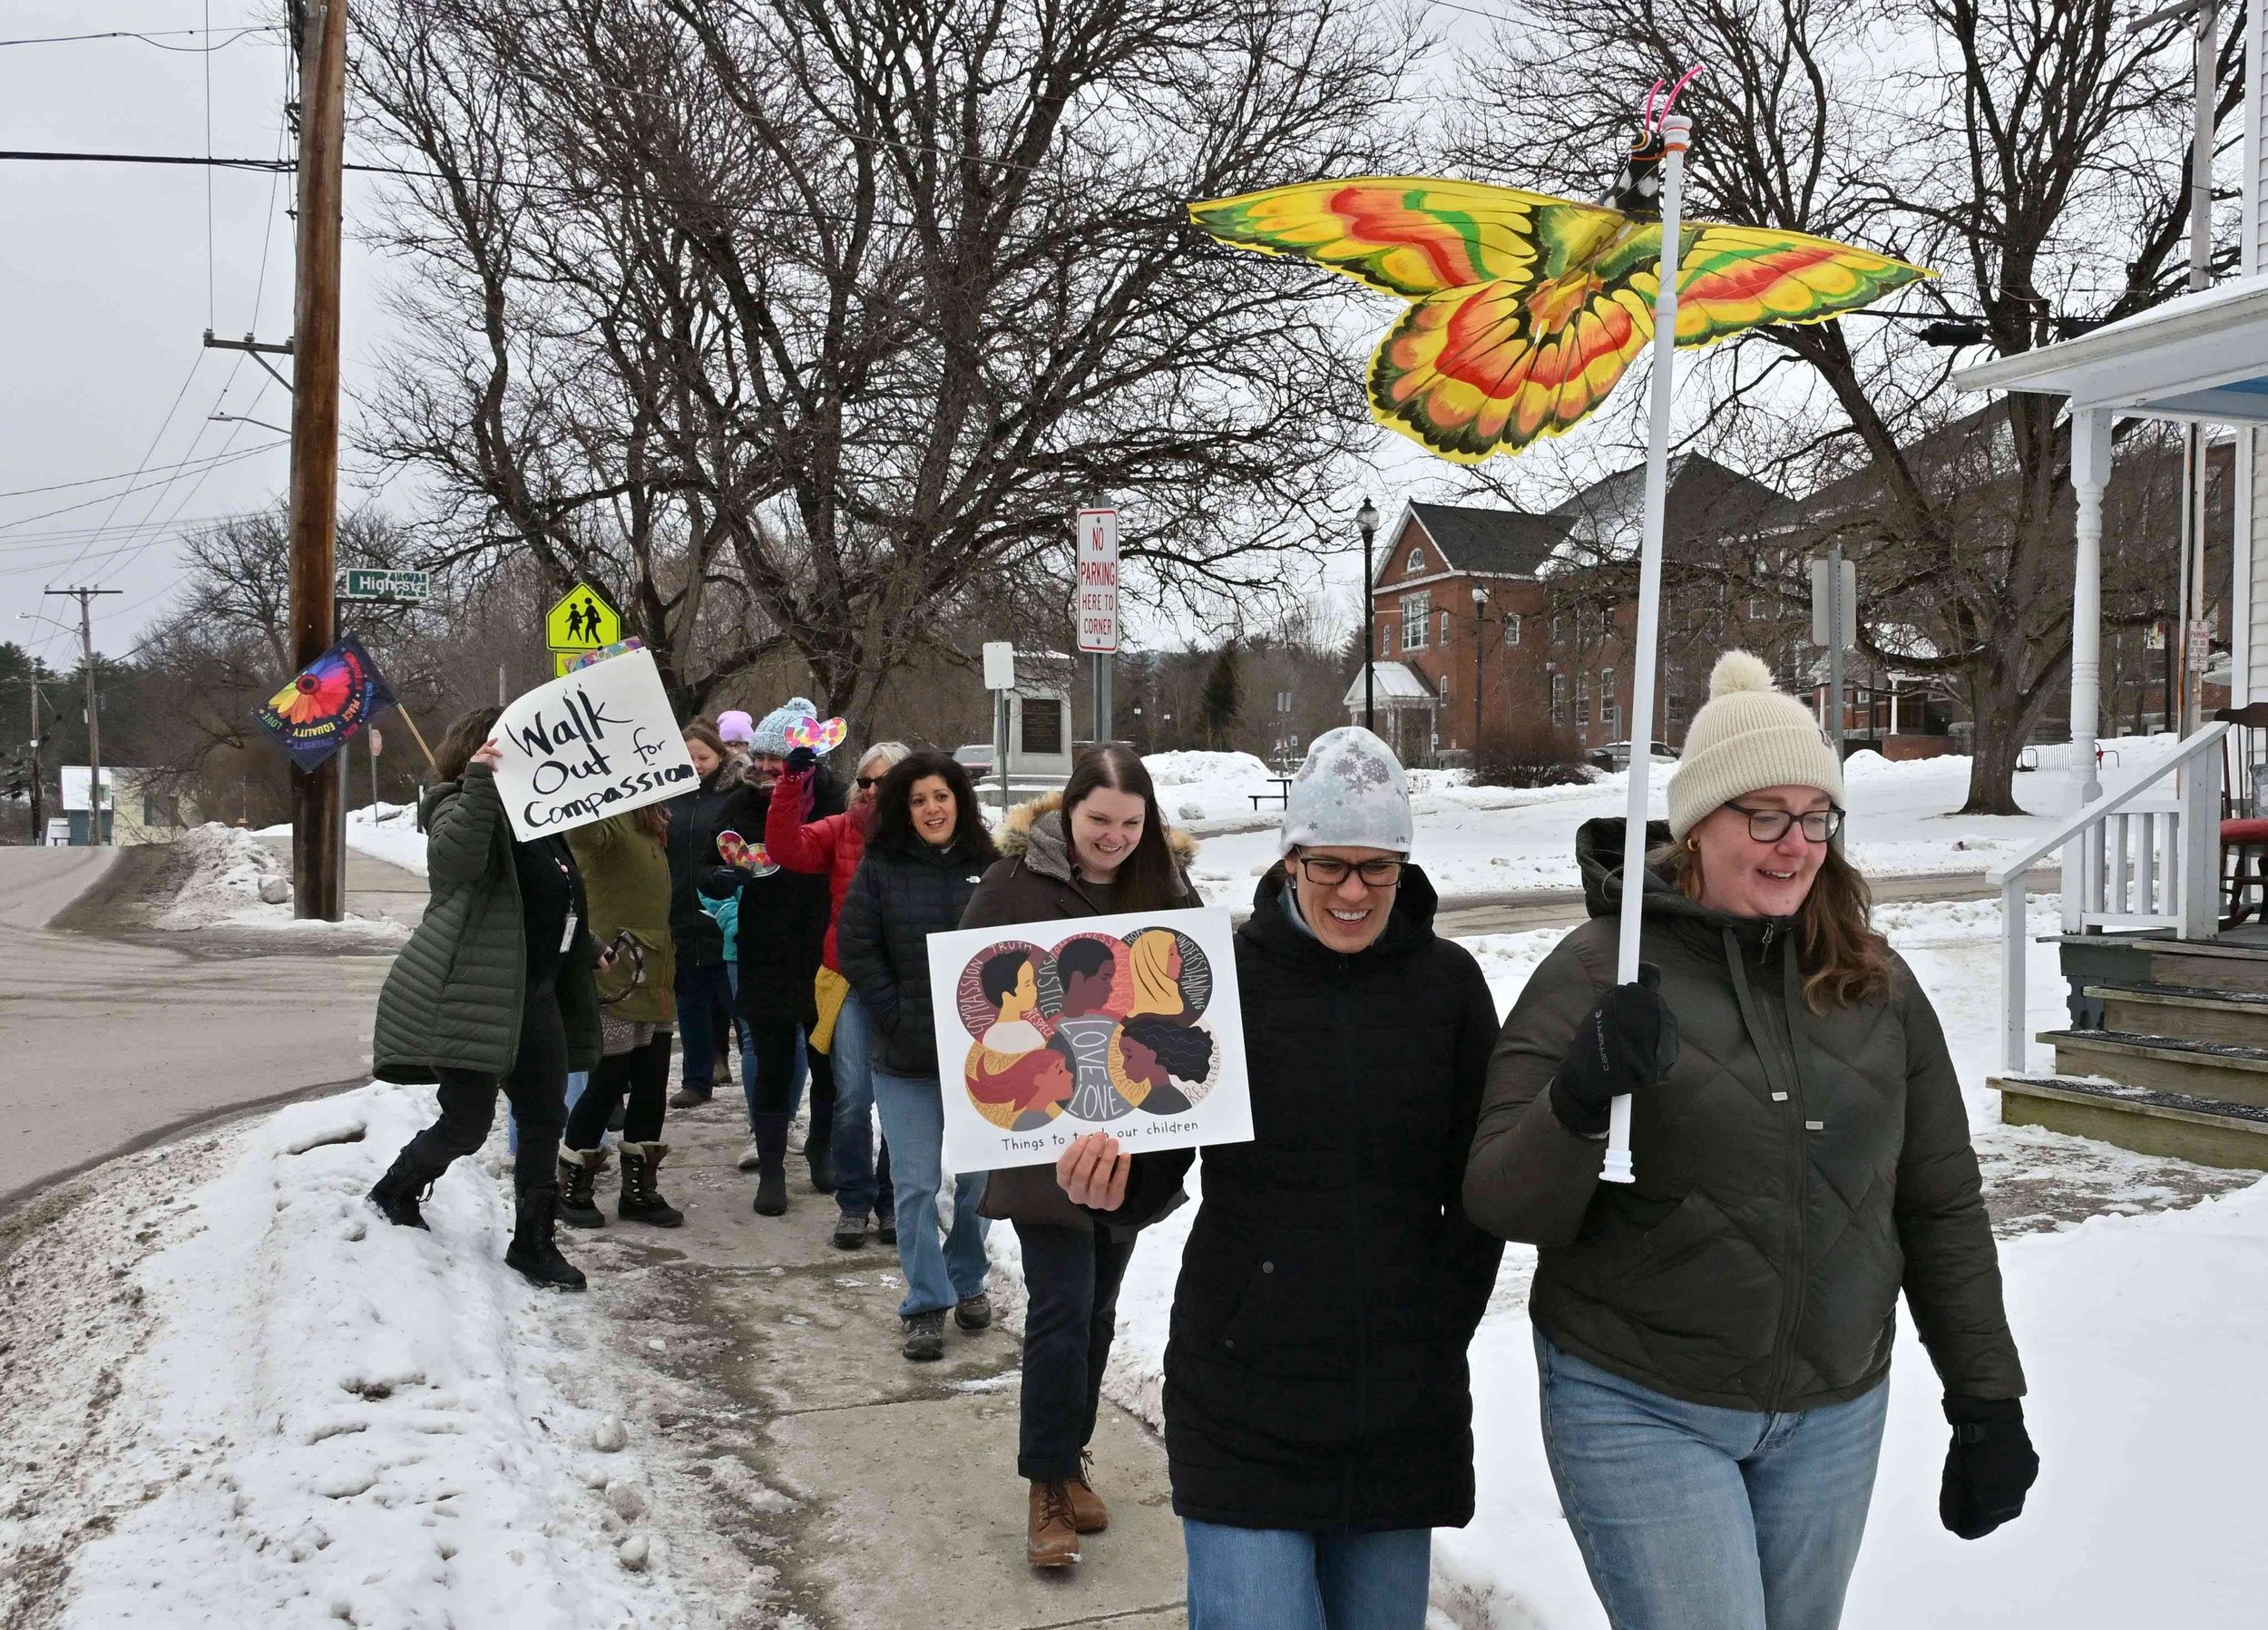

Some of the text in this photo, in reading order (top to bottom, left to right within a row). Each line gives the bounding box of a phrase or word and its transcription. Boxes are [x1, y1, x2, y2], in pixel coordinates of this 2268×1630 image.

[1092, 527, 1104, 551] NO
[359, 574, 394, 595] High
[1080, 561, 1115, 587] PARKING
[1082, 594, 1114, 611] HERE TO
[1084, 618, 1112, 635] CORNER
[261, 712, 283, 729] LOVE
[341, 698, 361, 722] PEACE
[505, 683, 634, 757] Walk
[292, 722, 336, 737] EQUALITY
[533, 727, 666, 795] Out for
[988, 942, 1032, 954] TRUTH
[1177, 933, 1208, 1010] UNDERSTANDING
[959, 958, 996, 1035] COMPASSION
[1037, 955, 1064, 1019] JUSTICE
[1022, 1007, 1056, 1038] RESPECT
[1060, 1020, 1113, 1081] LOVE
[1184, 1044, 1220, 1105] RESILIENCE
[1068, 1083, 1124, 1119] LOVE
[1002, 1137, 1044, 1151] Things
[1052, 1134, 1065, 1145] to
[1117, 1128, 1138, 1138] our
[1147, 1122, 1198, 1135] children
